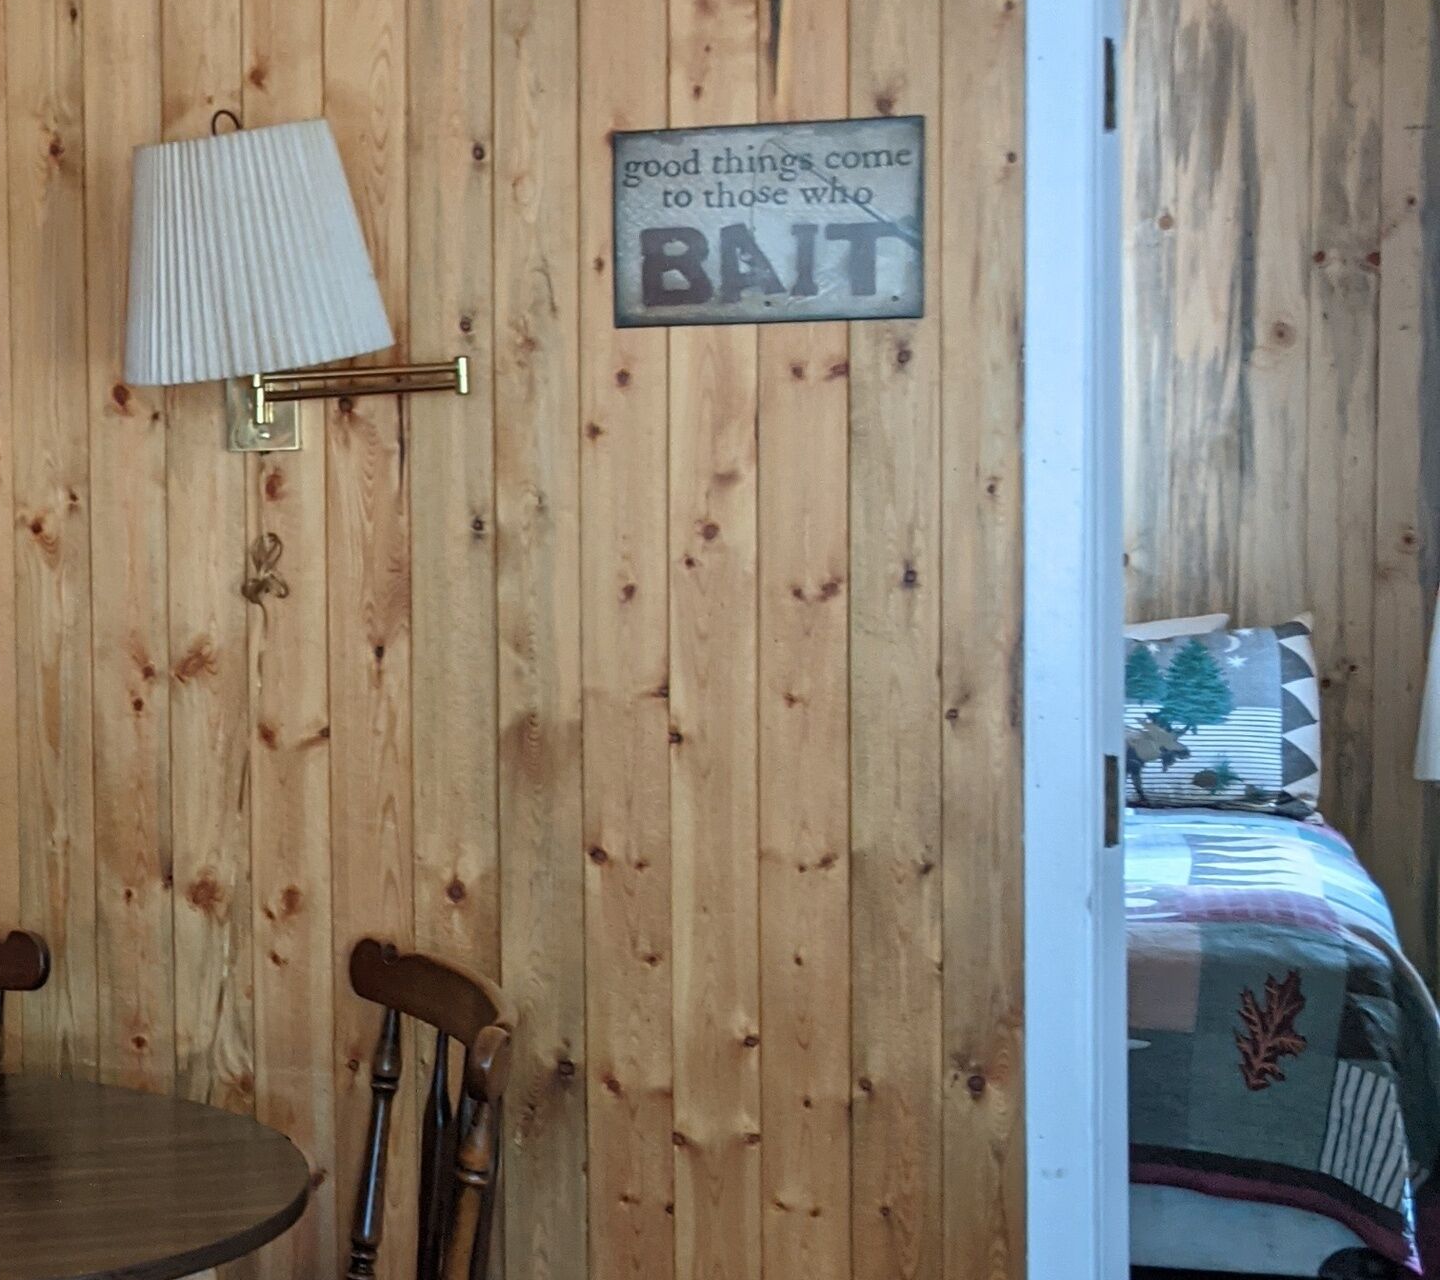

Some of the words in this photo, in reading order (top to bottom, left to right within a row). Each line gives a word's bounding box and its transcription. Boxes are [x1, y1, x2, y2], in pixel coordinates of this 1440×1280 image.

[622, 149, 700, 188] good
[713, 144, 814, 182] things
[824, 147, 913, 170] come
[662, 189, 692, 208] to
[703, 181, 788, 209] those
[800, 176, 874, 205] who
[639, 222, 903, 308] BAIT
